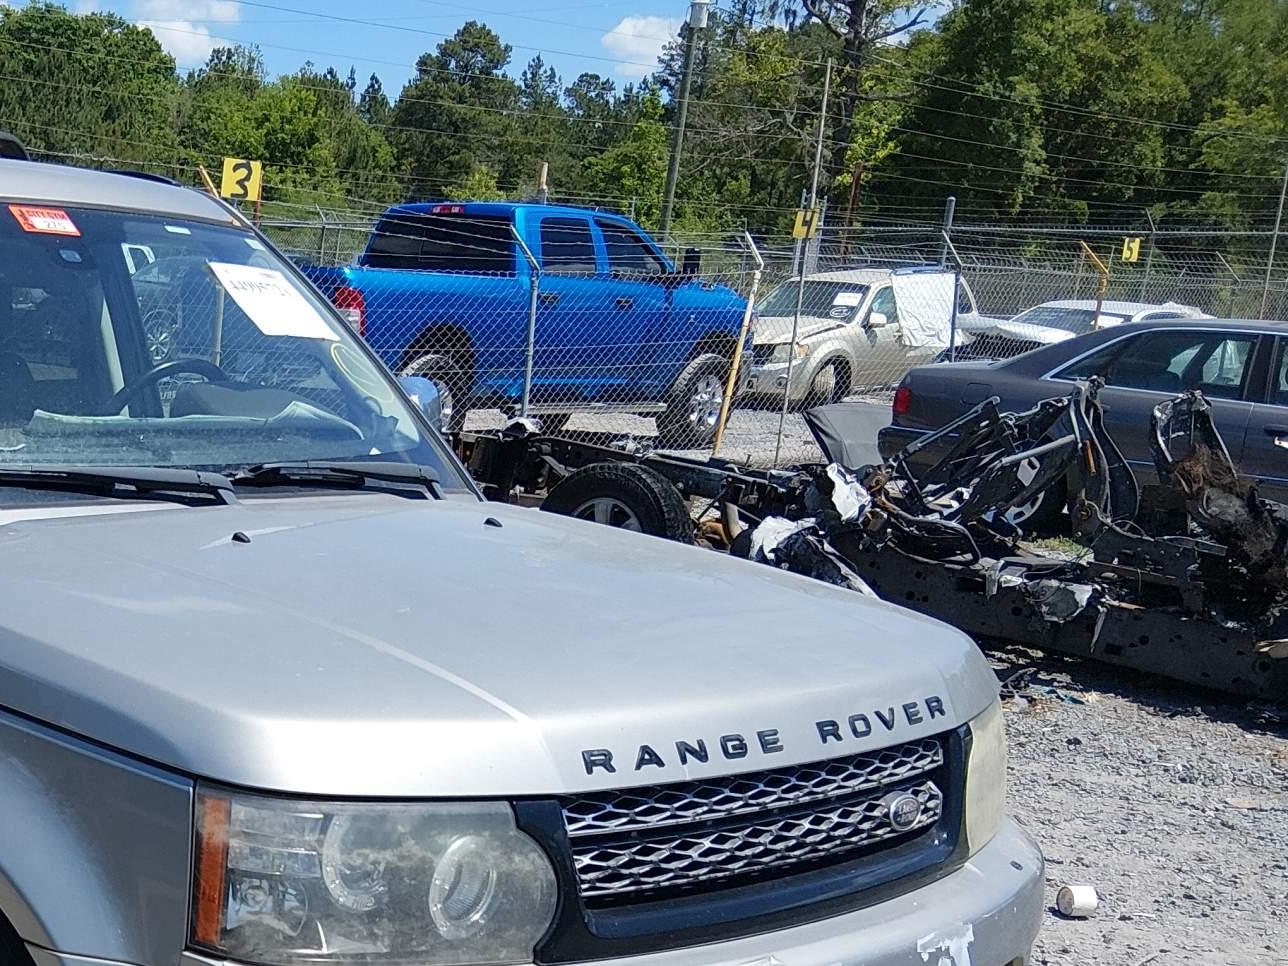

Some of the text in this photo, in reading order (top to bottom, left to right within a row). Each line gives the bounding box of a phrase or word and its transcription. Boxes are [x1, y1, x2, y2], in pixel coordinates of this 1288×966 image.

[230, 161, 252, 198] 3
[1124, 238, 1136, 260] 5
[581, 695, 946, 776] RANGE ROVER
